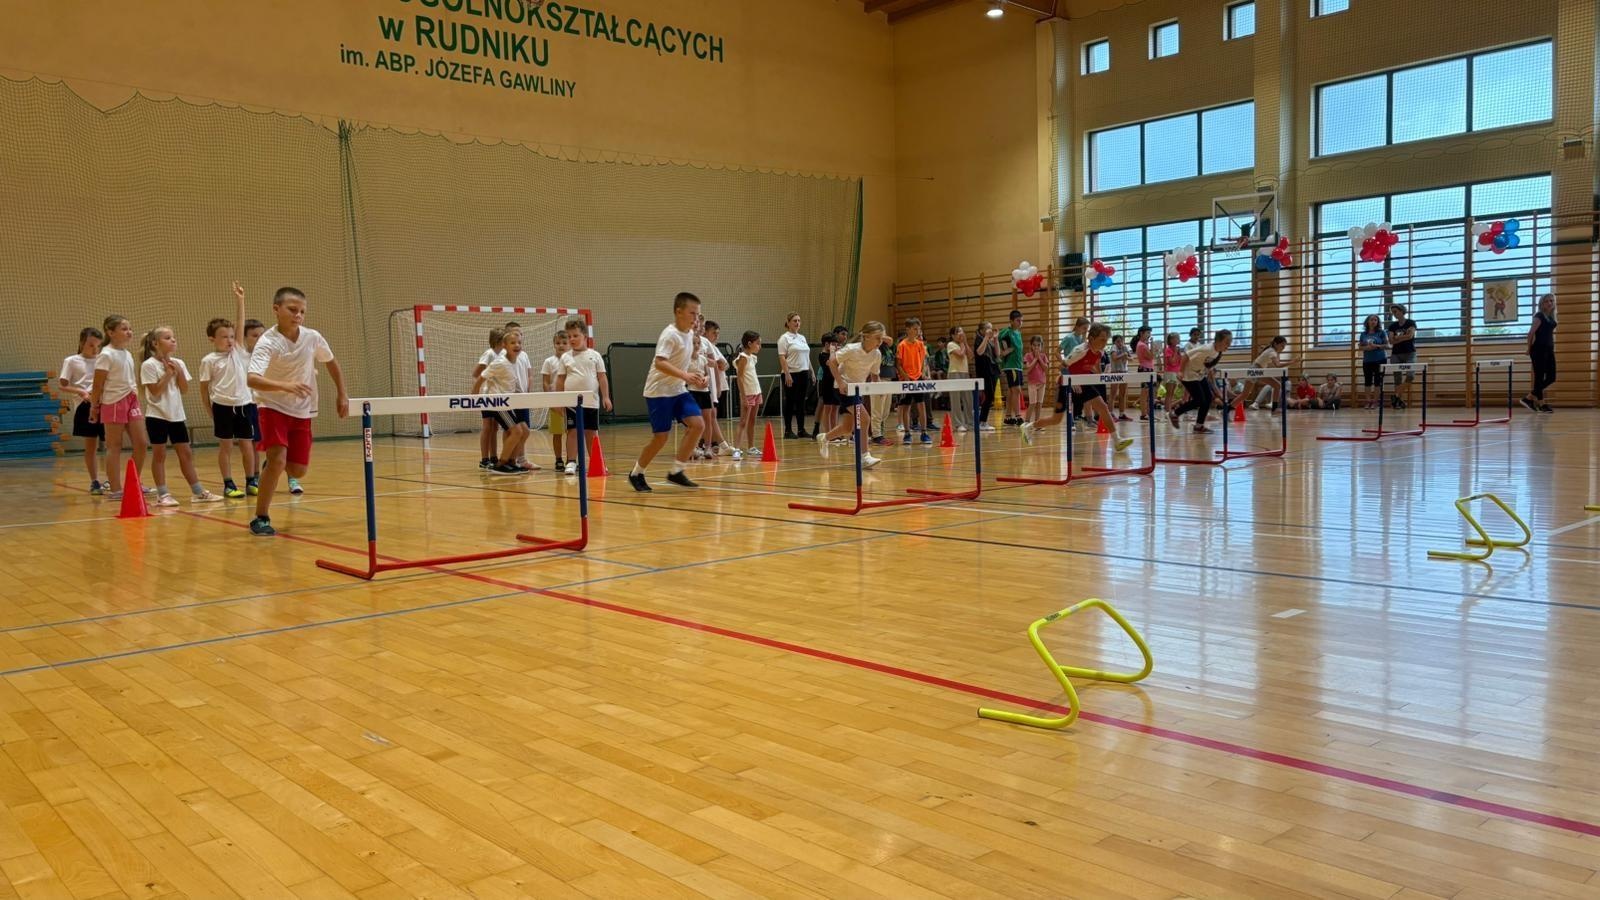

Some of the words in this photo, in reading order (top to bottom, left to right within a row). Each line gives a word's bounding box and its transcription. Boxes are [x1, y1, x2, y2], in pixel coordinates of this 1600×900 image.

[415, 15, 549, 67] RUDNIKU
[340, 44, 369, 67] im.
[375, 50, 419, 75] ABP.
[425, 57, 496, 86] JÓZEFA
[500, 70, 576, 98] GAWLINY
[1100, 375, 1124, 383] POLANIK
[901, 382, 936, 391] POLANIK
[449, 396, 510, 409] POLANIK
